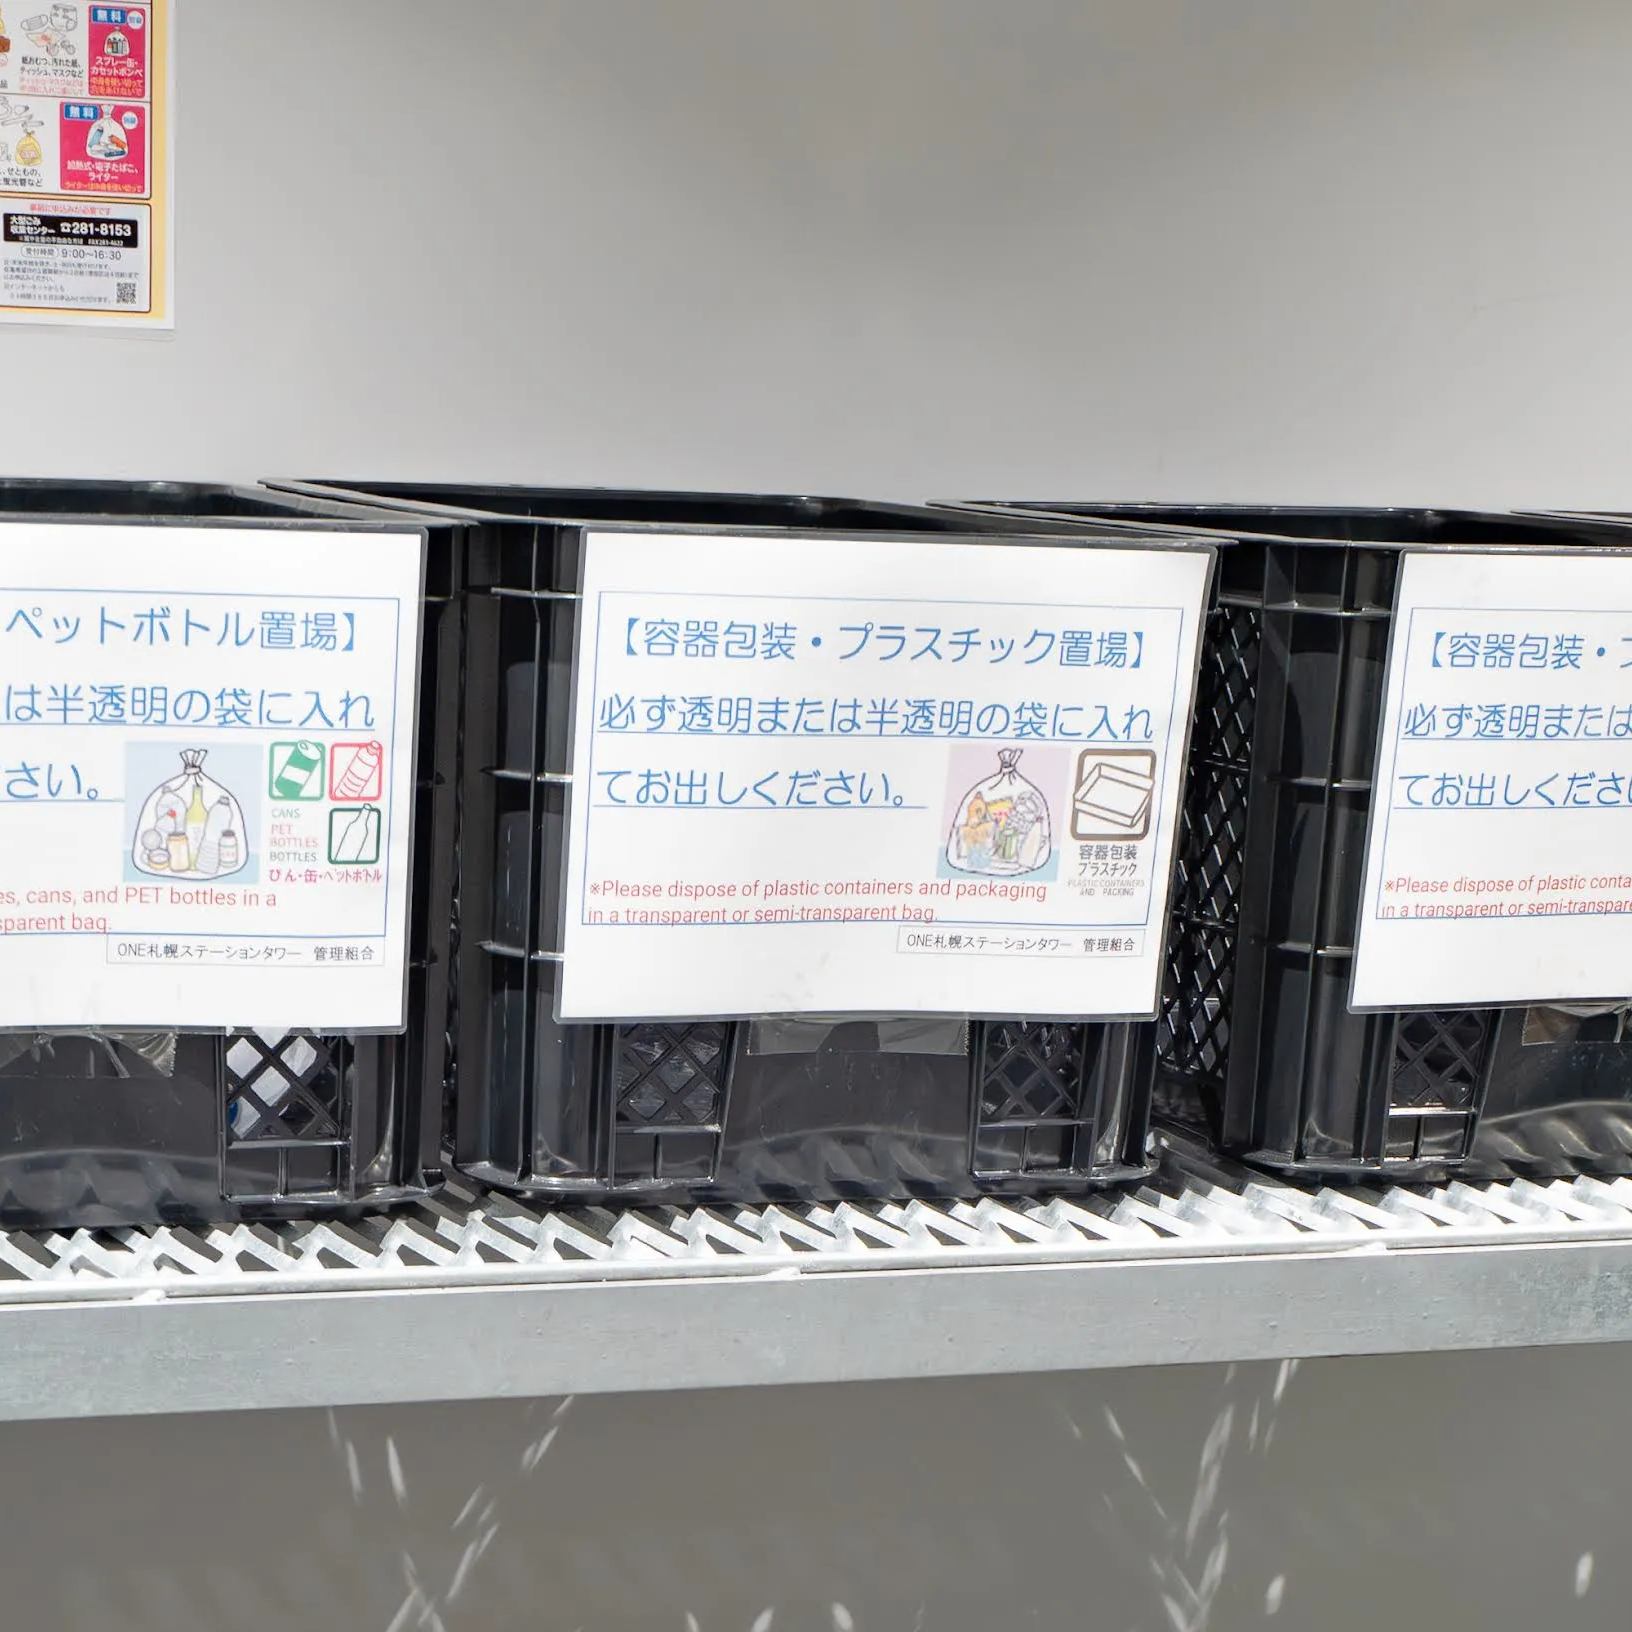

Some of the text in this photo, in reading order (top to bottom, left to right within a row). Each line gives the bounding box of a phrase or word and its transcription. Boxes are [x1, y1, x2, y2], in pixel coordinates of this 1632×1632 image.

[72, 222, 131, 237] 281-8153
[624, 618, 1144, 670] 【容器包装・プラスチック置場】
[598, 694, 1153, 740] 必ず透明または半透明の袋に入れ
[597, 768, 904, 807] てお出しください。
[1079, 844, 1138, 861] 容器包装
[1078, 862, 1137, 877] プラスチック
[589, 878, 1047, 902] ※Please dispose of plastic containers and packaging
[588, 904, 938, 926] in a transparent or semi-transparent bag.
[117, 943, 374, 961] ONE札幌ステーションタワー 管理組合
[907, 934, 1135, 952] ONE札幌ステーションタワー 管理組合
